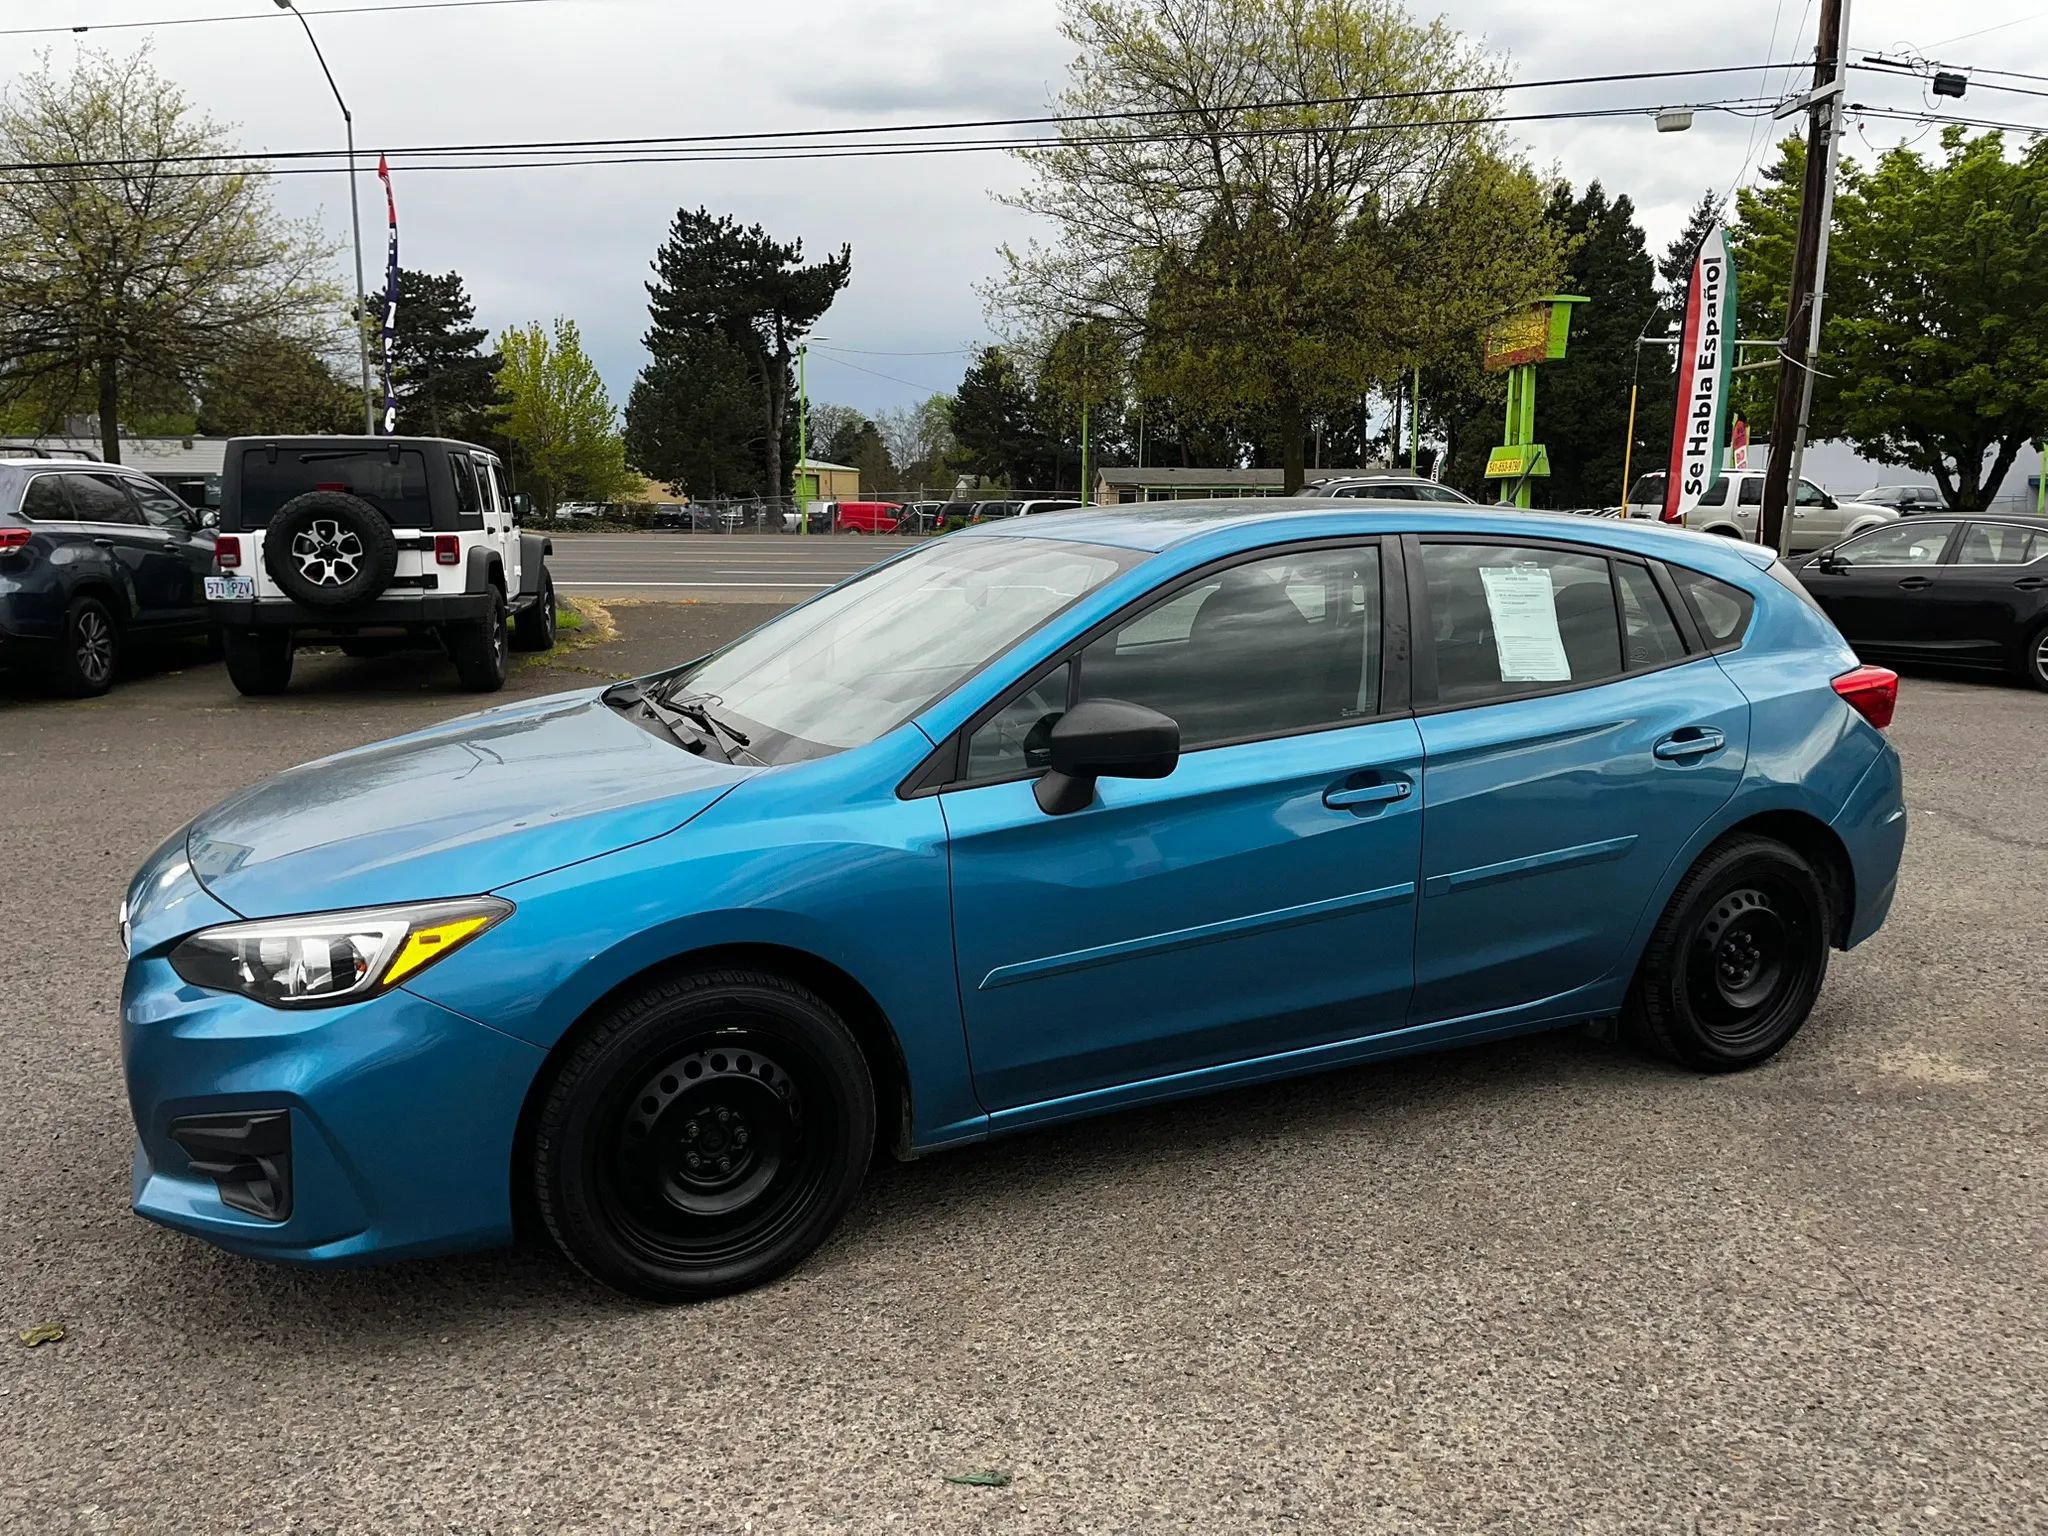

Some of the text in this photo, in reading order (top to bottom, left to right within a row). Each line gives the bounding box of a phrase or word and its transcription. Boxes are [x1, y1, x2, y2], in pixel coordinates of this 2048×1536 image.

[1685, 257, 1722, 495] Se Habla Español
[207, 582, 250, 595] 571 PZV
